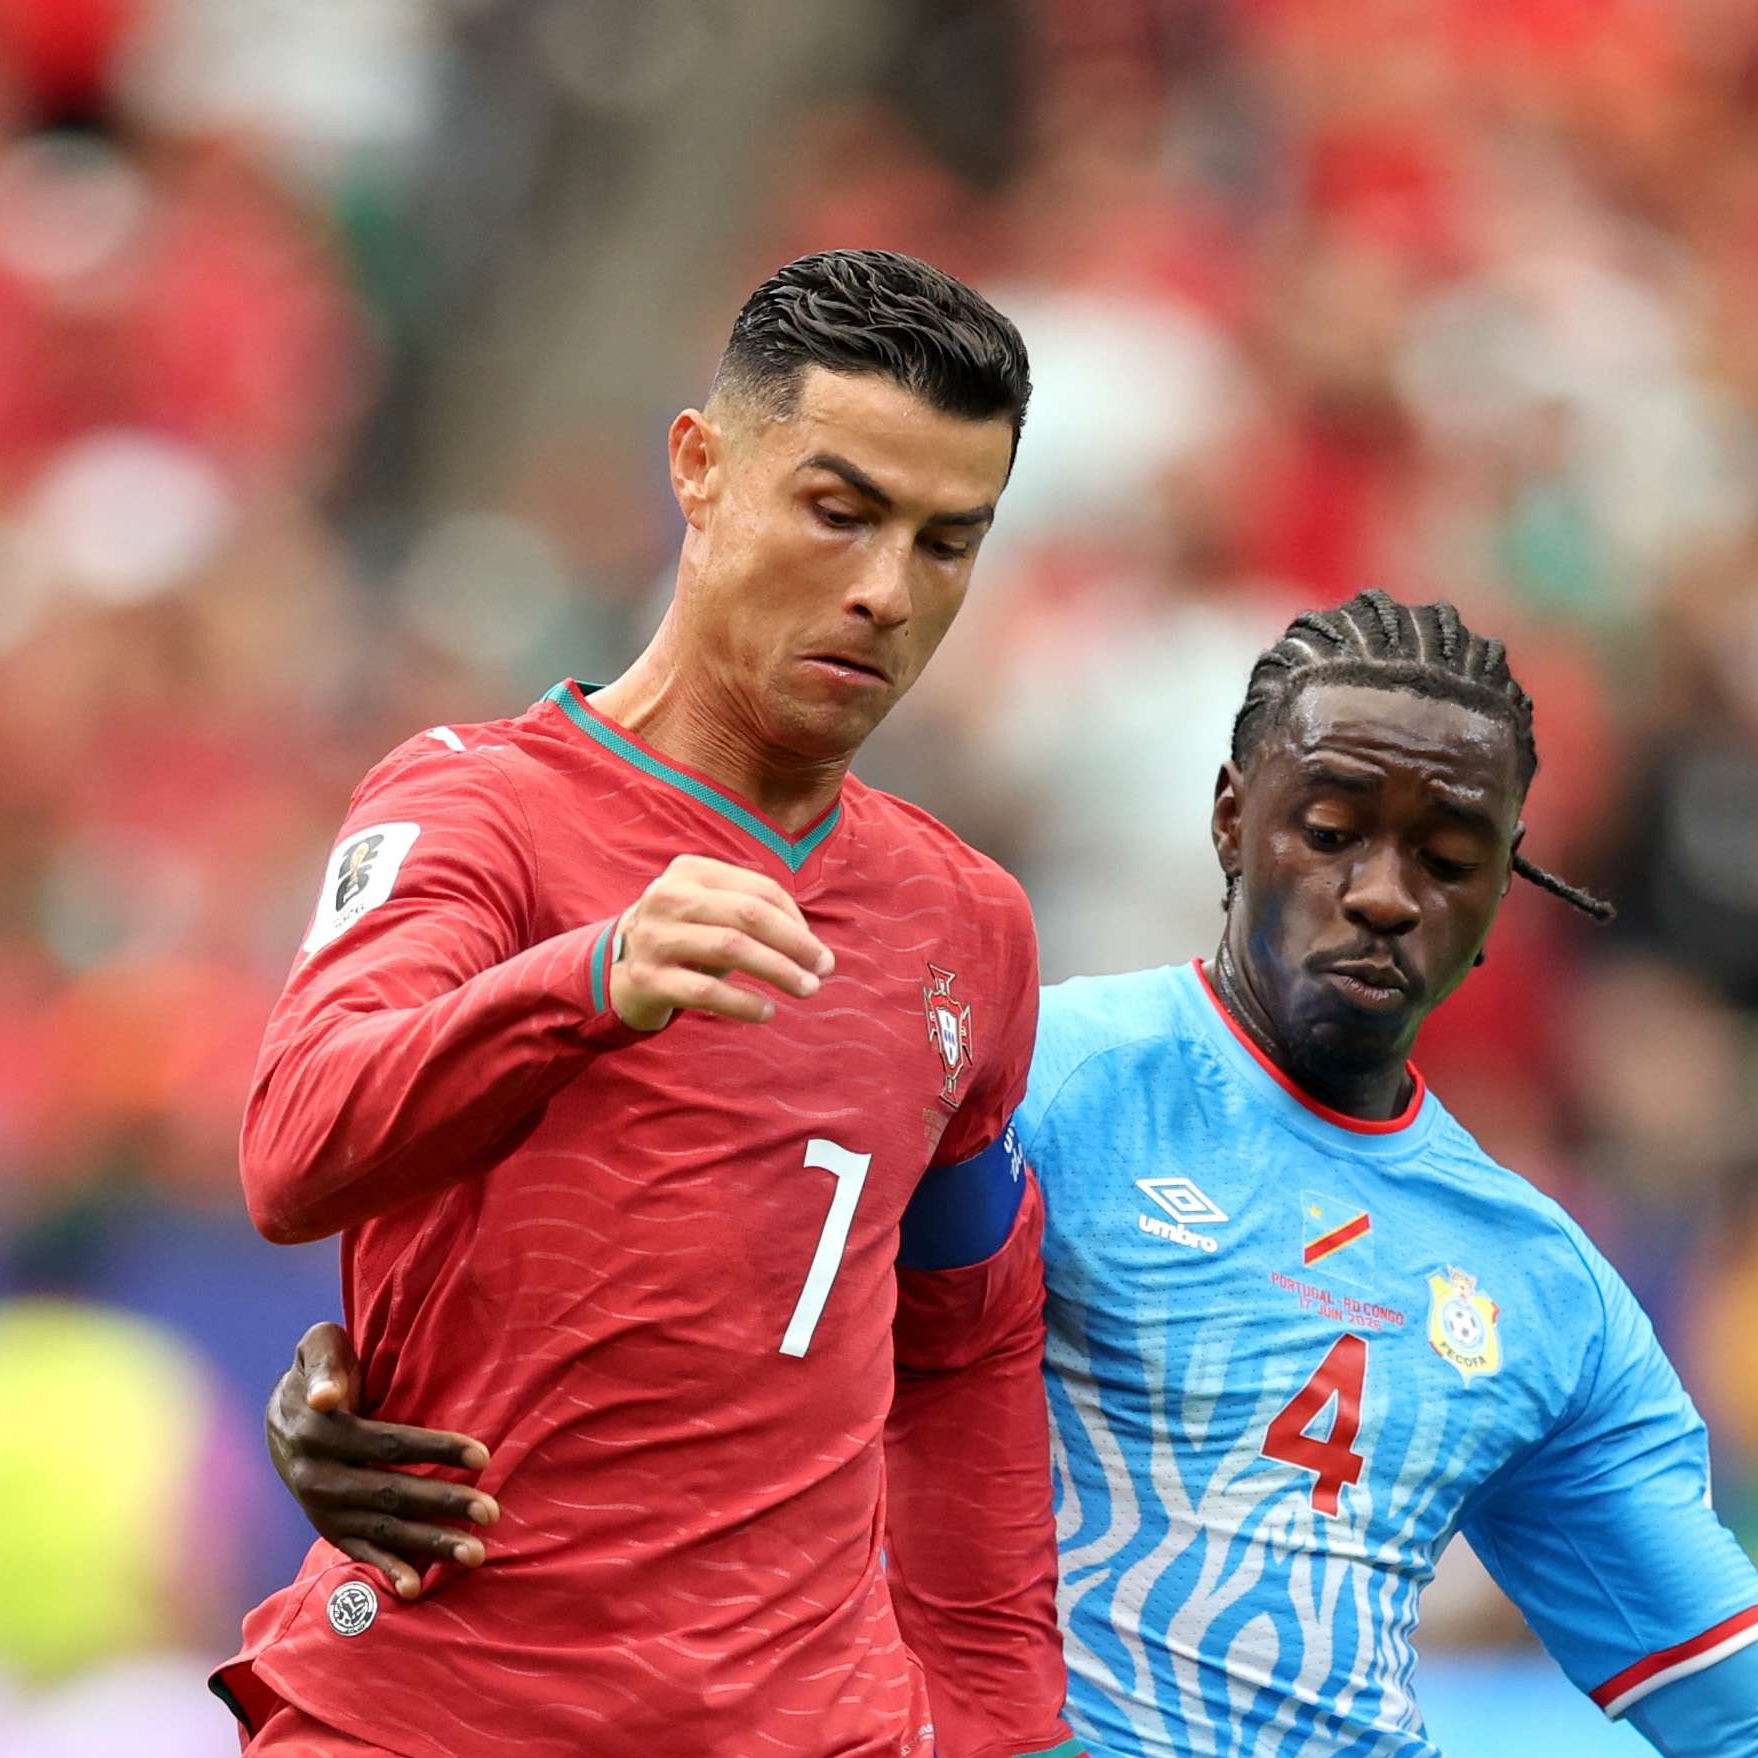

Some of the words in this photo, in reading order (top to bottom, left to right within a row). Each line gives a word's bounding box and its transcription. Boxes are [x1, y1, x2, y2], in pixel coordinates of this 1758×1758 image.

[779, 1138, 872, 1359] 7
[1138, 1213, 1219, 1254] umbro
[1271, 1271, 1335, 1305] PORTUGAL
[1363, 1302, 1405, 1326] CONGO
[1318, 1305, 1343, 1321] JUIN
[1440, 1341, 1488, 1368] FECOFA
[1259, 1331, 1369, 1520] 4
